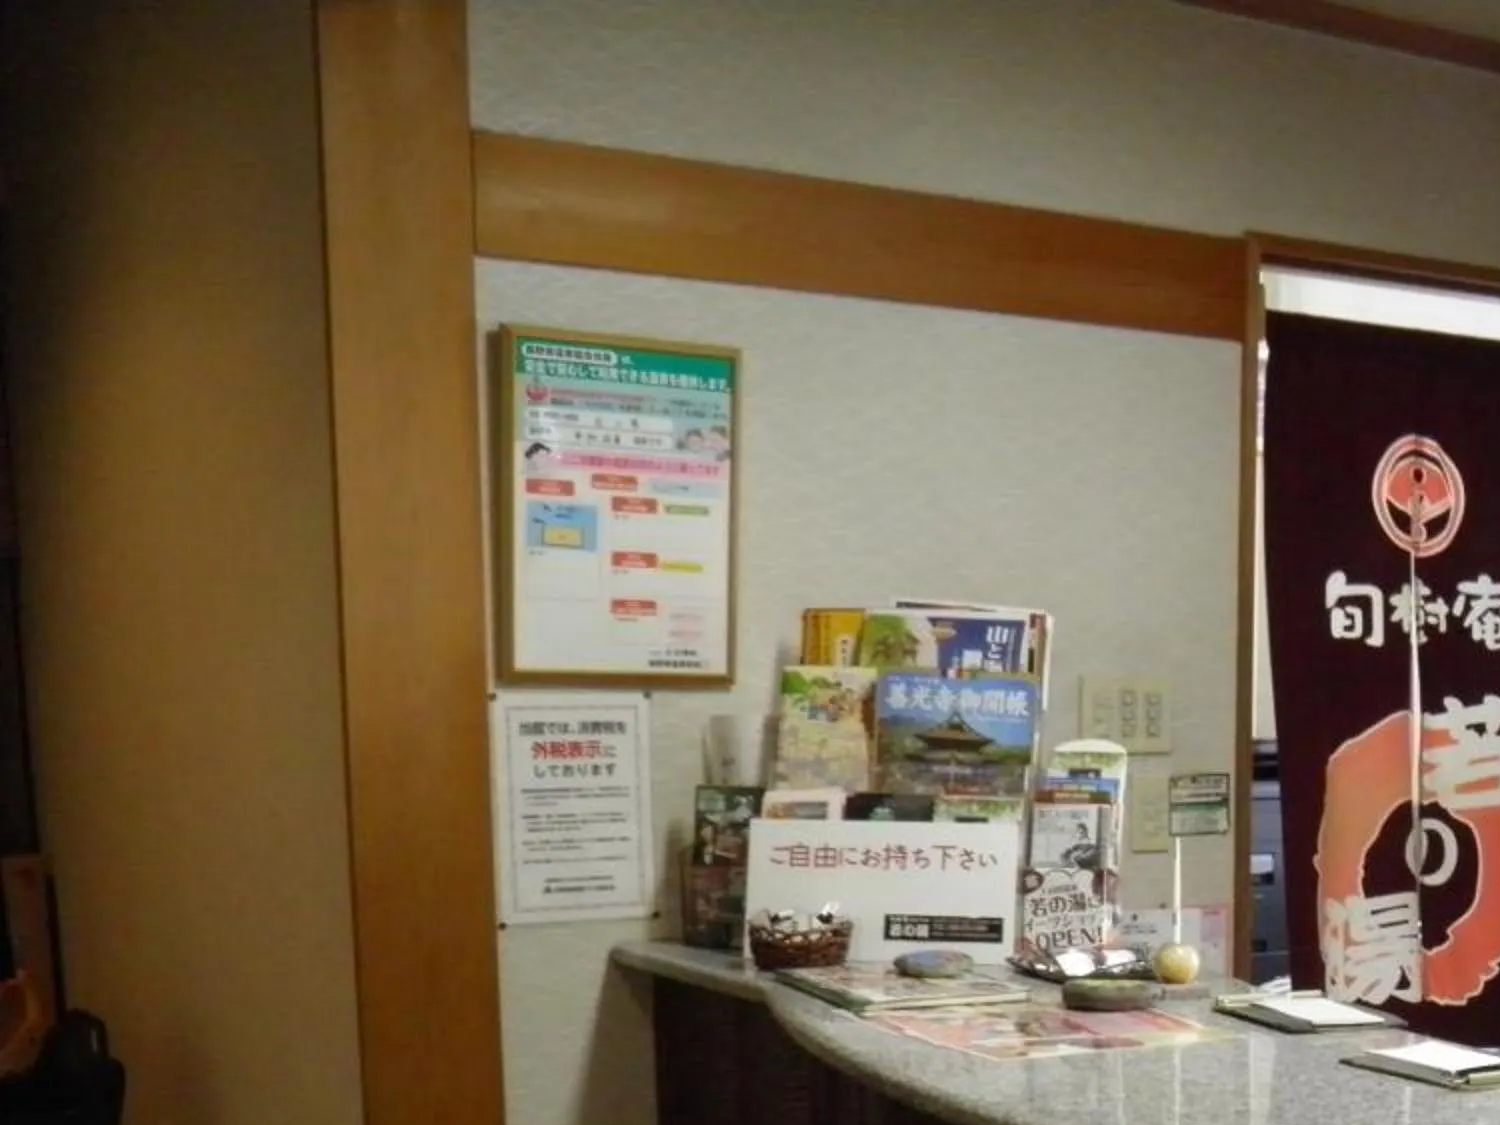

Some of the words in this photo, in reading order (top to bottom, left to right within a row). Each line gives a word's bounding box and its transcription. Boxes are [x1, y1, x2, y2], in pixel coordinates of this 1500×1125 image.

[768, 842, 998, 871] ご自由にお持ち下さい
